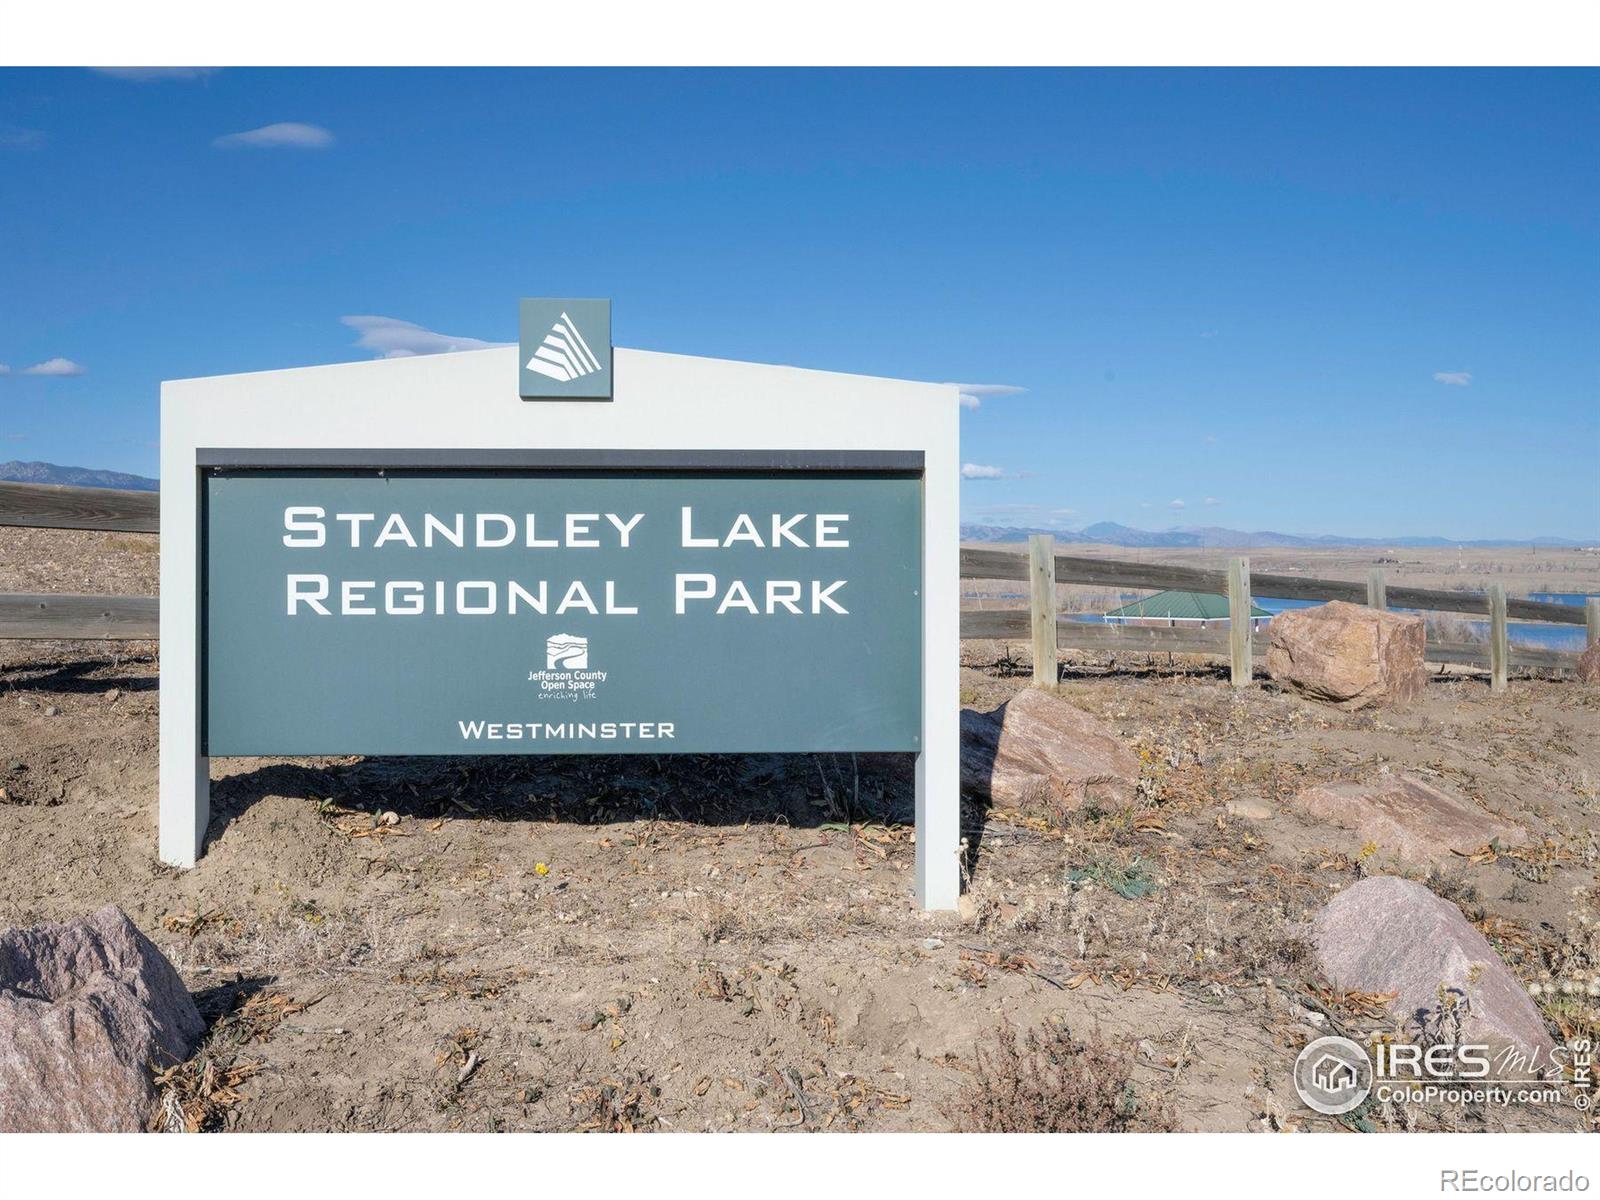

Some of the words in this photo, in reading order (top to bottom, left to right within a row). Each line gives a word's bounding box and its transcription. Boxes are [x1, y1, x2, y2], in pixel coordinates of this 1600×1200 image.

[282, 506, 645, 548] STANDLEY
[681, 506, 850, 548] LAKE
[286, 573, 638, 615] REGIONAL
[675, 573, 849, 615] PARK
[528, 671, 571, 681] Jefferson
[574, 671, 607, 682] County
[541, 681, 565, 690] Open
[567, 681, 595, 691] Space
[538, 690, 578, 702] enriching
[583, 688, 597, 699] life
[458, 720, 675, 740] WESTMINSTER
